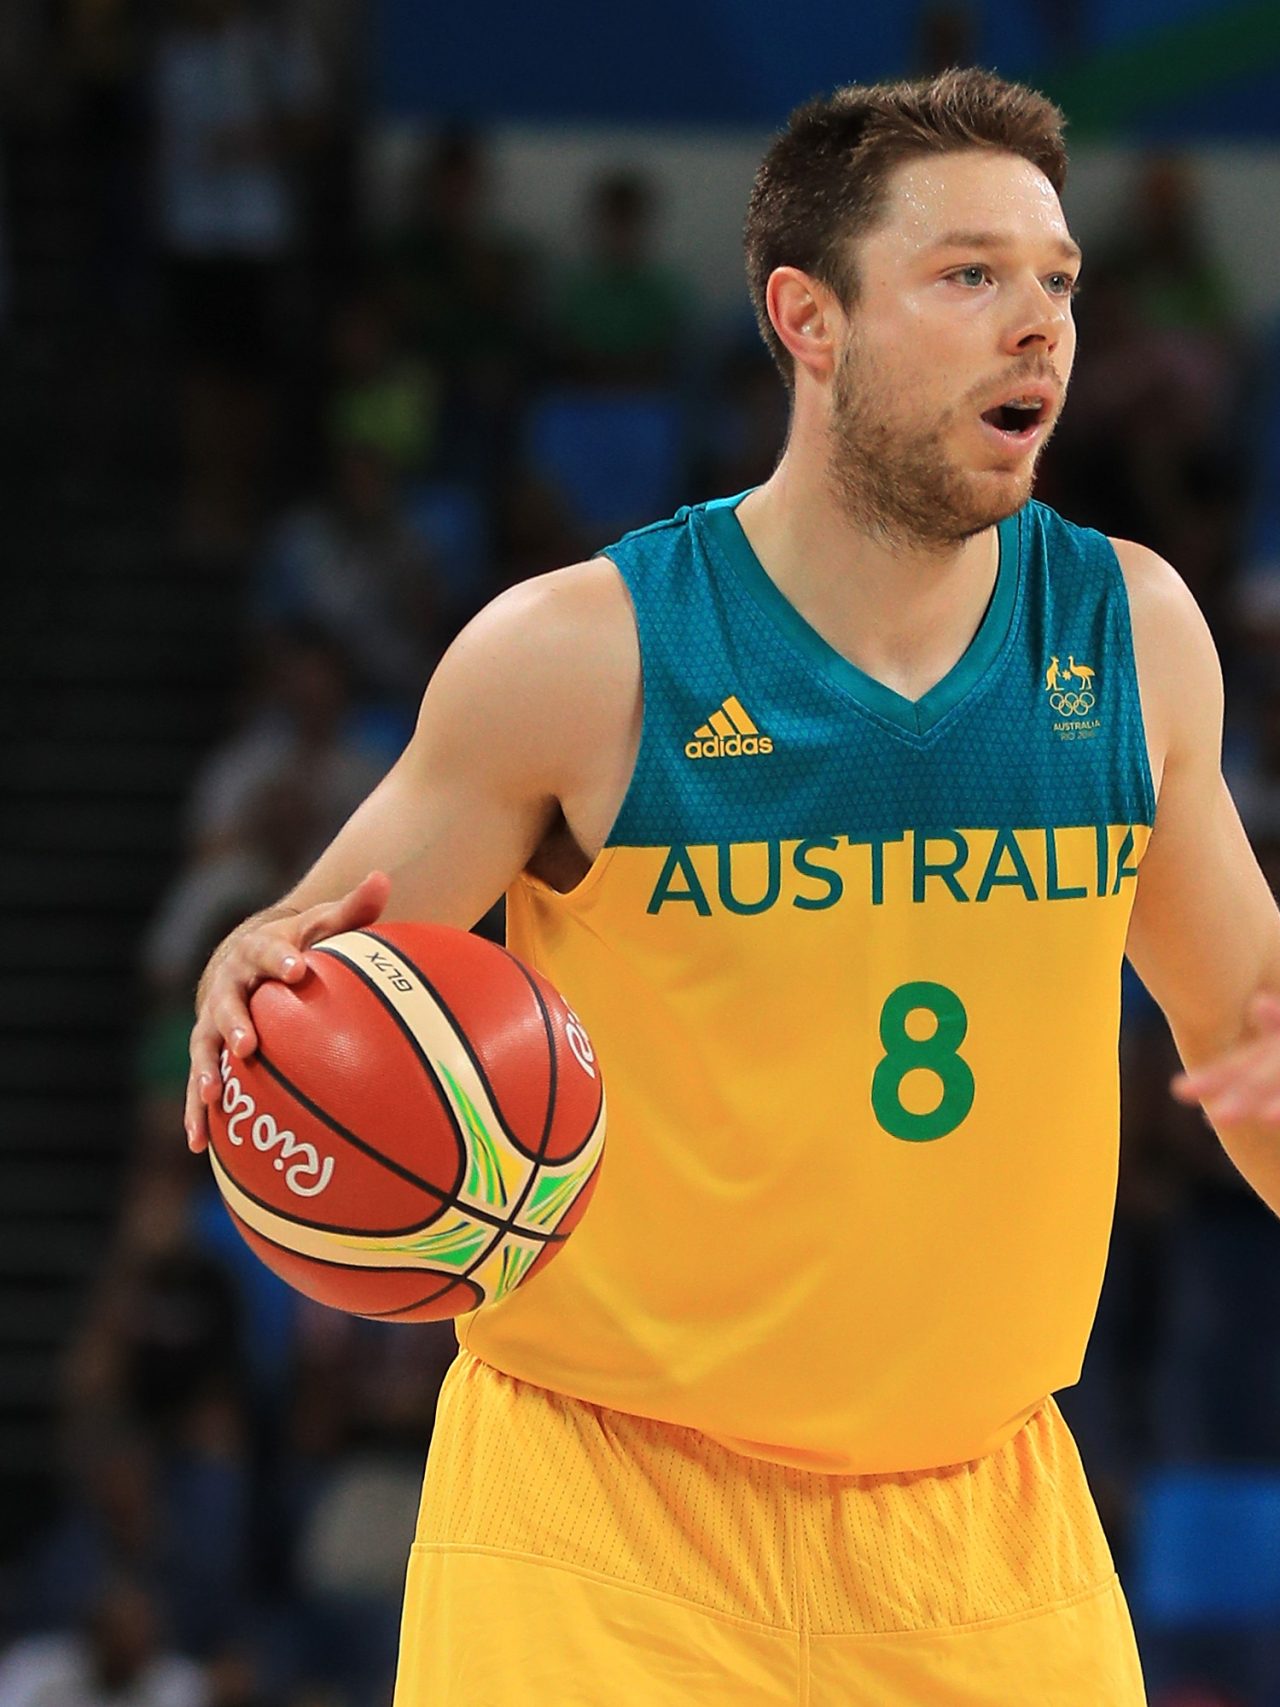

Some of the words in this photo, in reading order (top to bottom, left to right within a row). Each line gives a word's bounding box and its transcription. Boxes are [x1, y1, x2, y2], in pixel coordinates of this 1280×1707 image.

[1053, 719, 1101, 731] AUSTRALIA
[685, 734, 773, 758] adidas
[646, 826, 1138, 916] AUSTRALIA
[365, 952, 412, 992] GL7X
[871, 980, 975, 1142] 8
